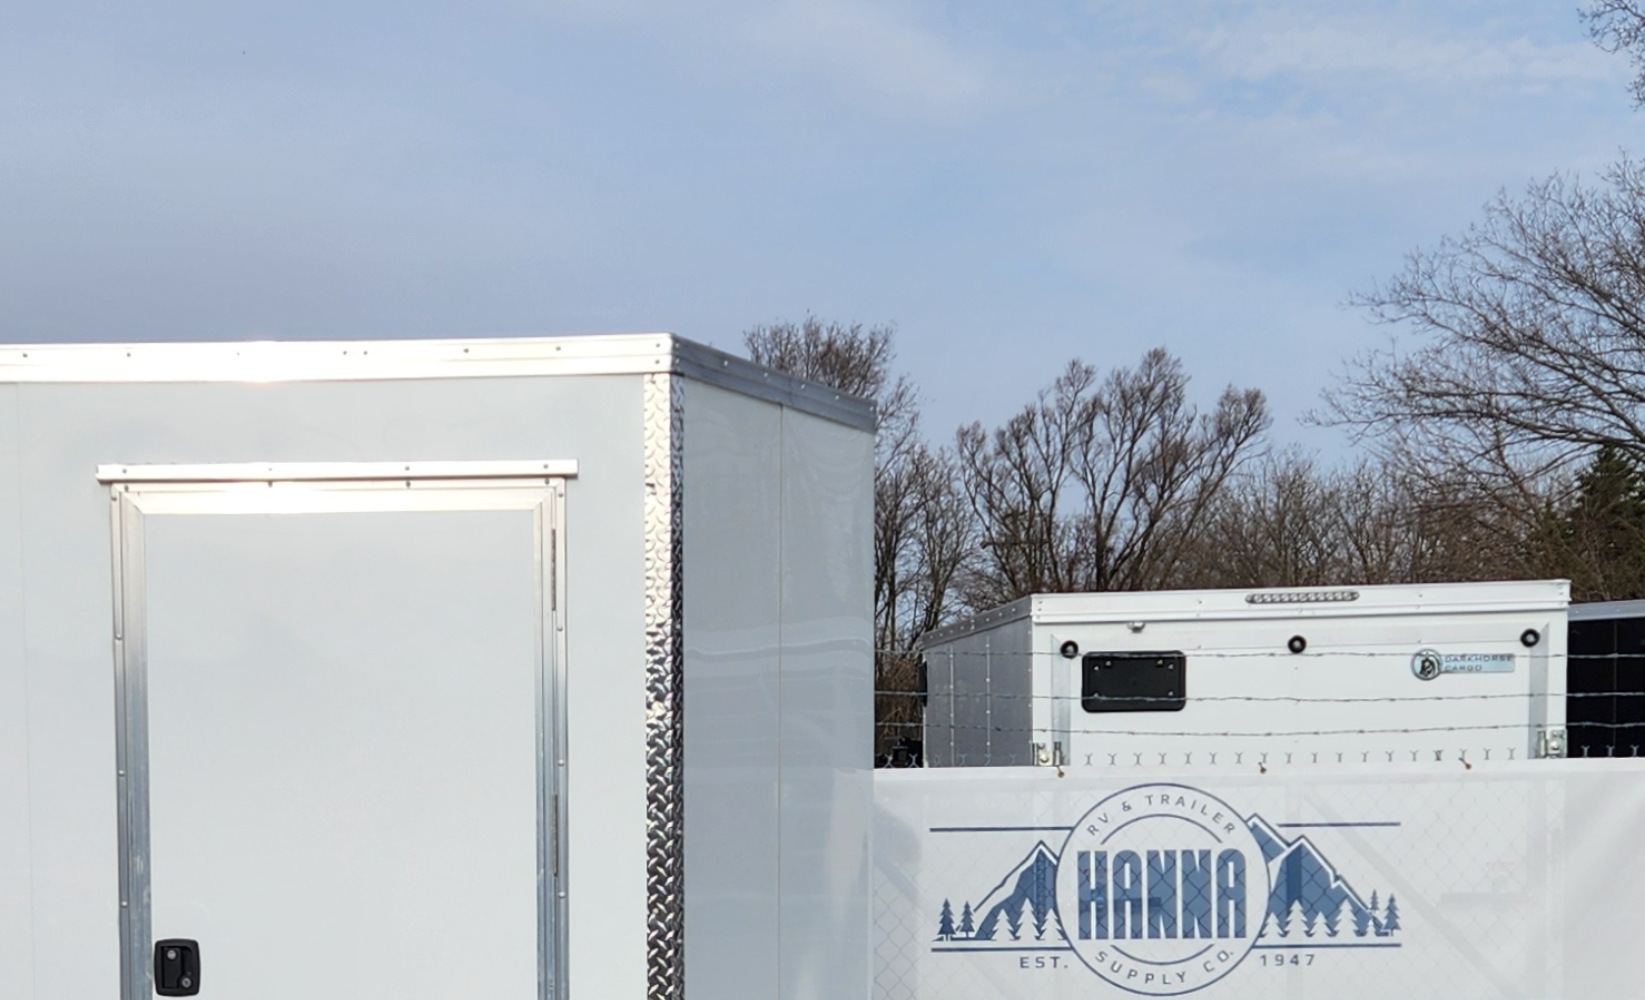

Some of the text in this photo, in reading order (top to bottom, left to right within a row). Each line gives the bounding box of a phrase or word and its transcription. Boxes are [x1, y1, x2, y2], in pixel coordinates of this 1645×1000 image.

[1444, 664, 1483, 672] CARGO
[1087, 794, 1236, 836] RV & TRAILER
[1077, 848, 1246, 940] HANNA
[1019, 954, 1315, 969] EST. 1947
[1095, 949, 1234, 985] SUPPLY CO.
